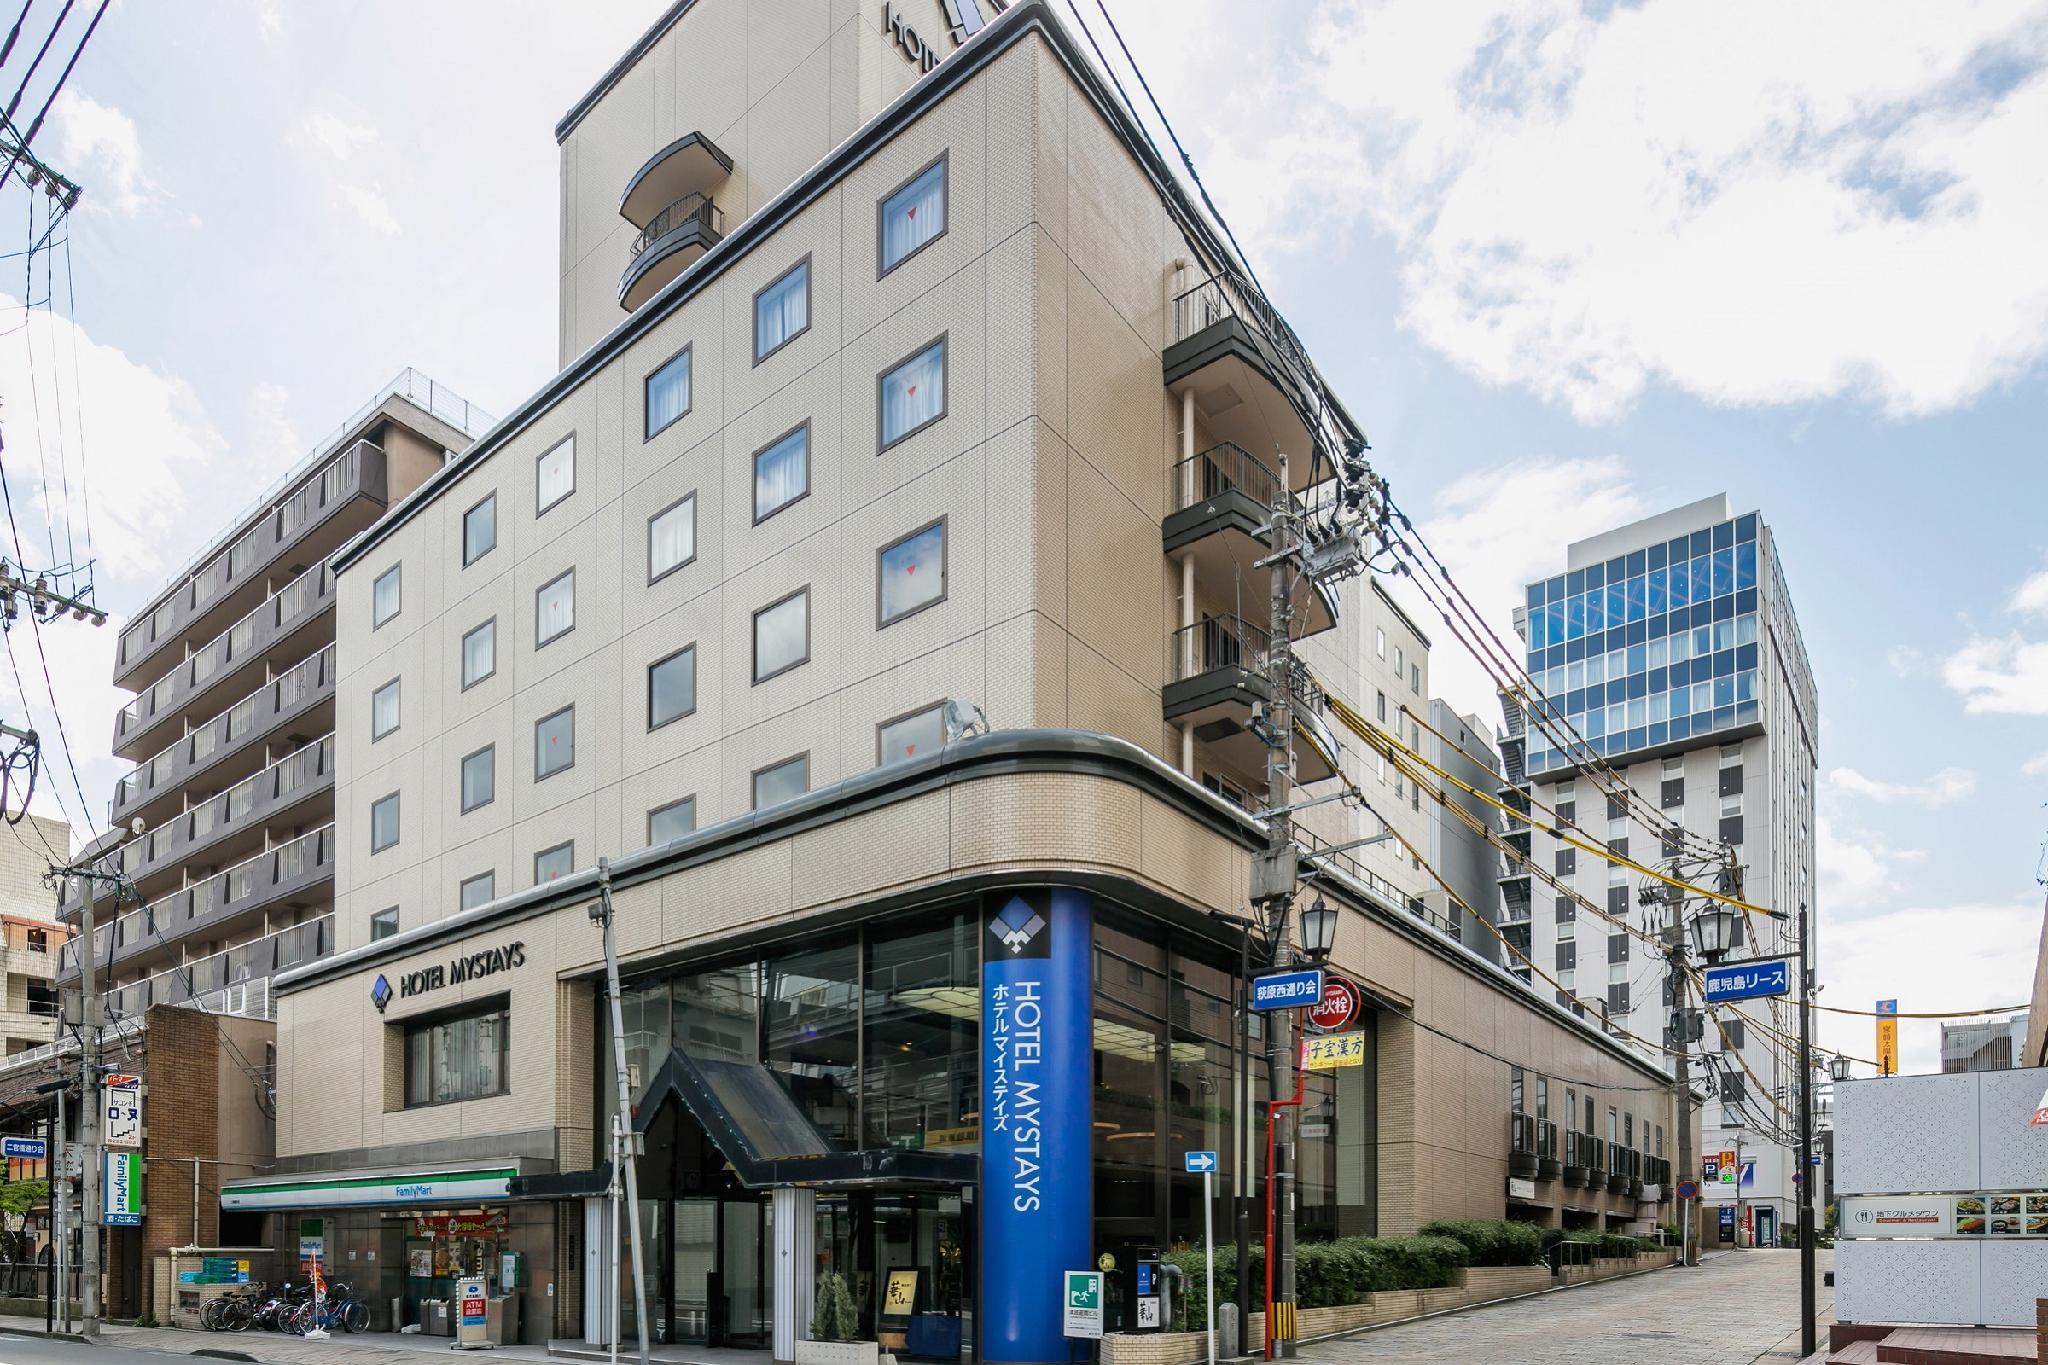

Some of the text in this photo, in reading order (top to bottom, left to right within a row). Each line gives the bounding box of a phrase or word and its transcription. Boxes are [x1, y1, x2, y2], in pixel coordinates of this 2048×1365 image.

[401, 941, 525, 998] HOTEL MYSTAYS
[1707, 971, 1784, 993] 鹿児島リース
[1312, 995, 1348, 1016] 消火栓
[992, 983, 1010, 1132] ホテルマイステイズ
[1311, 1036, 1363, 1059] 子宝漢方
[1013, 981, 1041, 1213] HOTEL MYSTAYS
[1705, 1164, 1716, 1174] P
[114, 1154, 127, 1212] FamilyMart
[396, 1185, 433, 1199] FamilyMart
[466, 1301, 483, 1309] ATM
